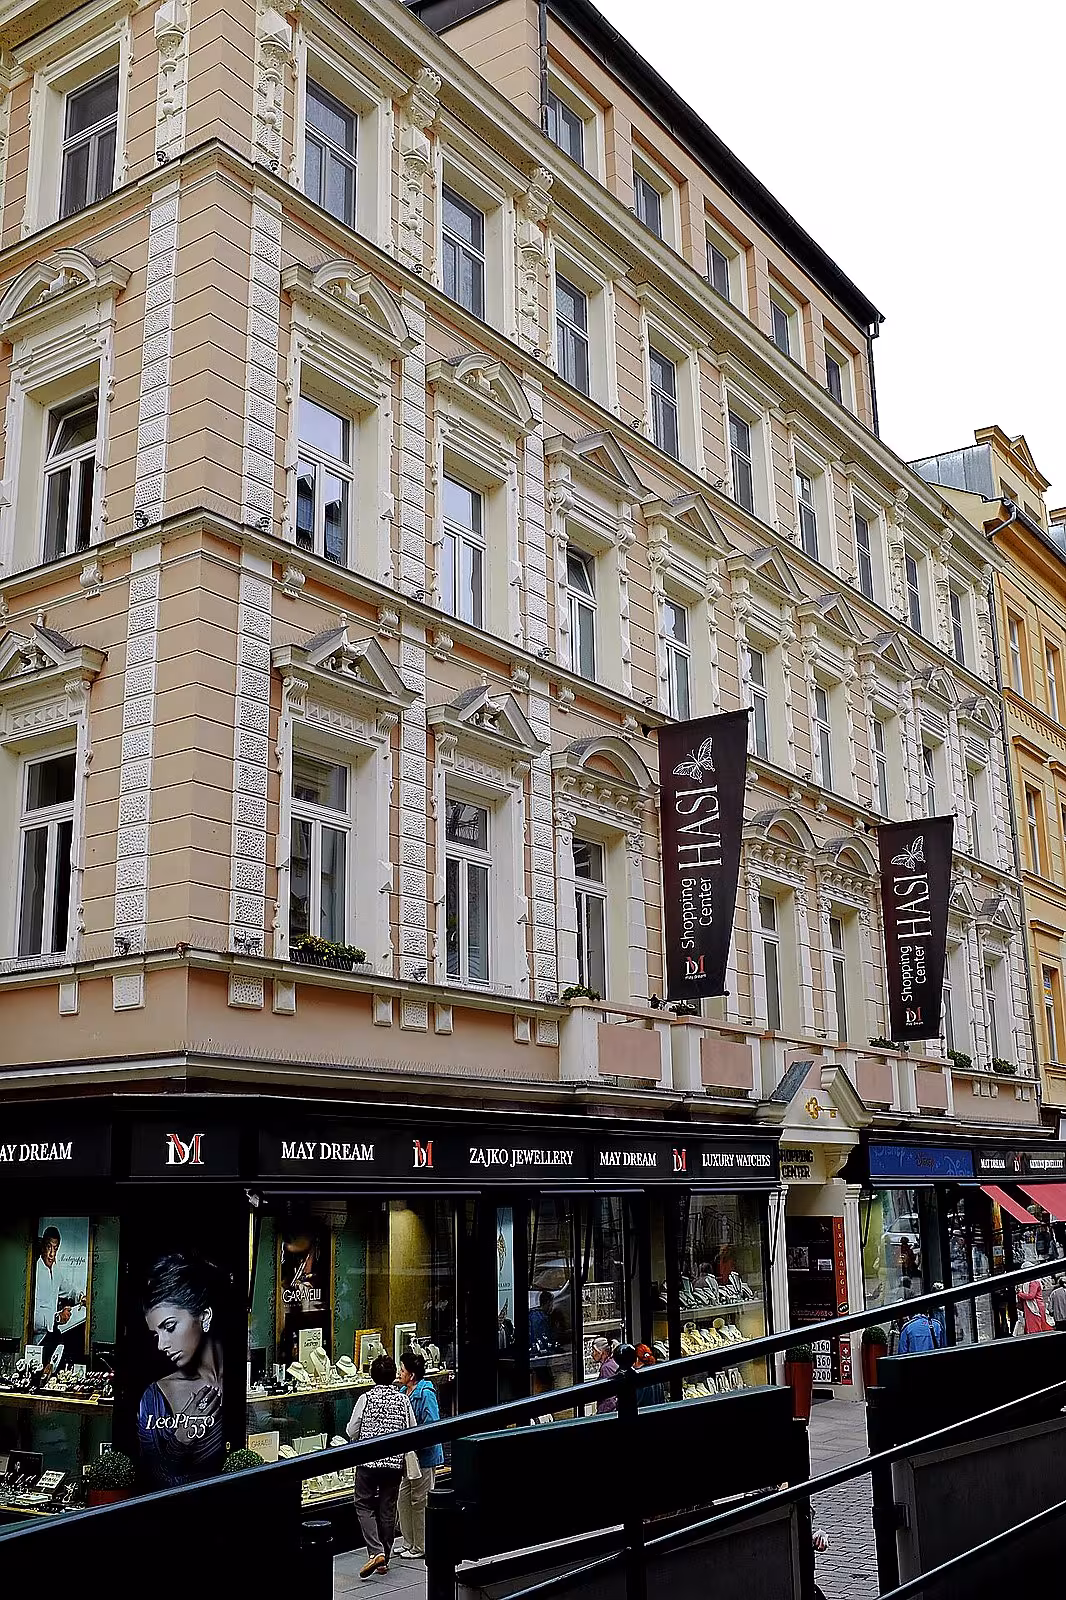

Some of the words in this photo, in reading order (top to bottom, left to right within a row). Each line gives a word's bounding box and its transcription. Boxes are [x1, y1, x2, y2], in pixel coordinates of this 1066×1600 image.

[676, 784, 723, 871] HASI
[679, 878, 697, 949] Shopping
[698, 877, 713, 926] Center
[893, 873, 933, 939] HASI
[900, 945, 913, 1002] Shopping
[914, 945, 926, 984] Center
[19, 1141, 73, 1161] DREAM
[281, 1141, 315, 1160] MAY
[319, 1142, 375, 1161] DREAM
[469, 1147, 508, 1165] ZAJKO
[510, 1149, 574, 1168] JEWELLERY
[599, 1151, 621, 1166] MAY
[622, 1152, 657, 1167] DREAM
[701, 1153, 734, 1167] LUXURY
[735, 1154, 771, 1167] WATCHES
[780, 1149, 814, 1163] HOPPING
[781, 1165, 811, 1178] CENTER
[836, 1223, 846, 1295] EXCHANGE
